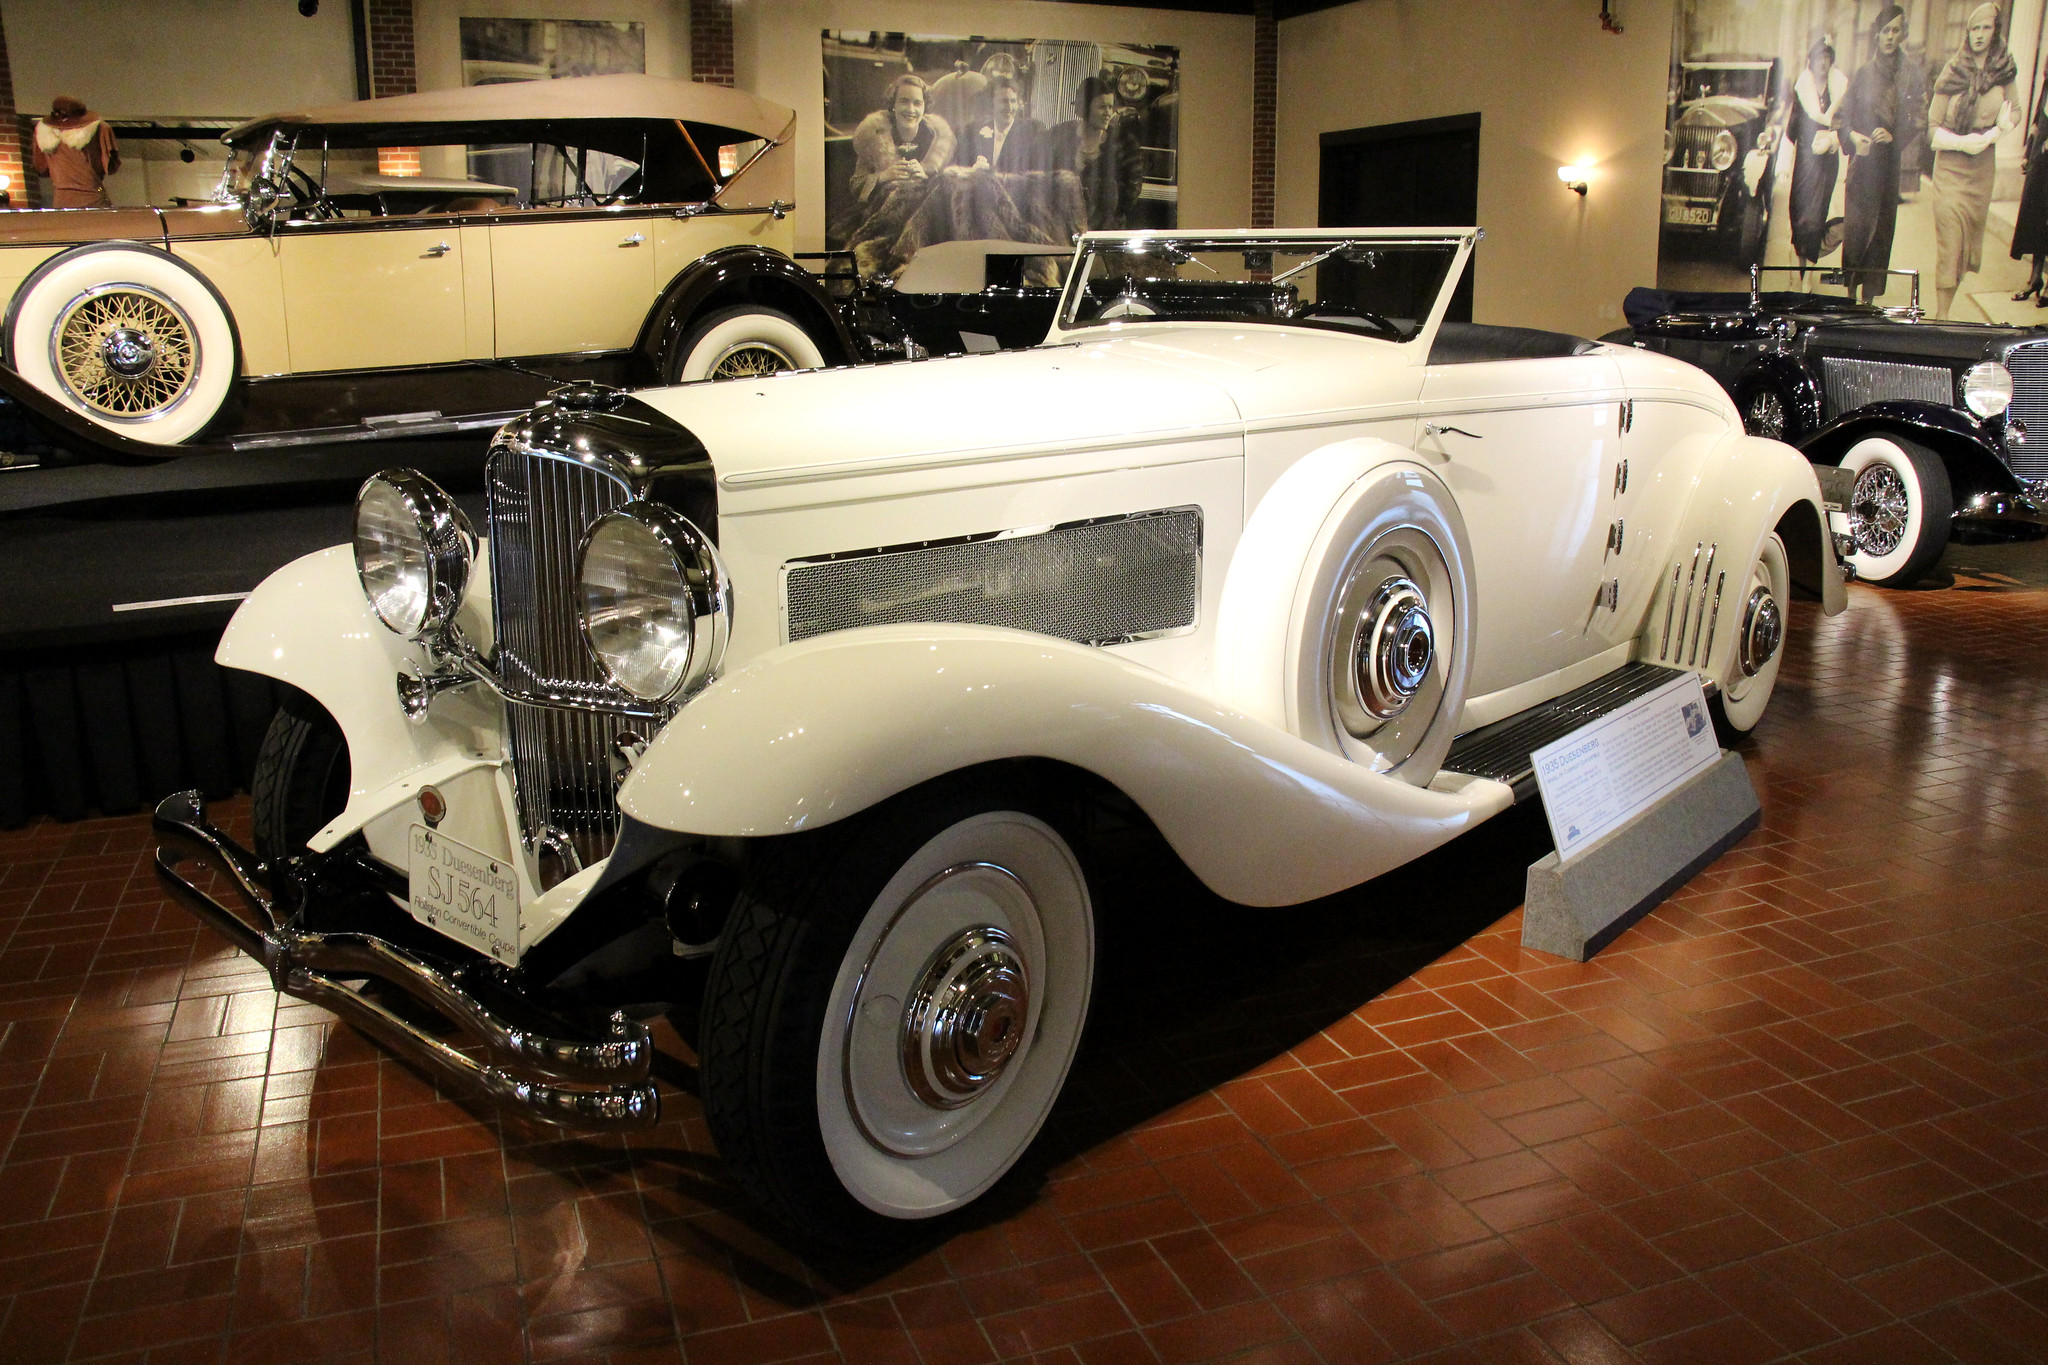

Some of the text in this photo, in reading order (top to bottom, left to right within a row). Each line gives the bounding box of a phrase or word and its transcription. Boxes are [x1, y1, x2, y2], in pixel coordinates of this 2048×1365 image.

[1541, 759, 1560, 776] 1935
[414, 834, 514, 900] 1935 Duesenberg
[427, 865, 498, 929] SJ 564
[442, 910, 487, 941] Convertible
[488, 932, 516, 955] Coupe
